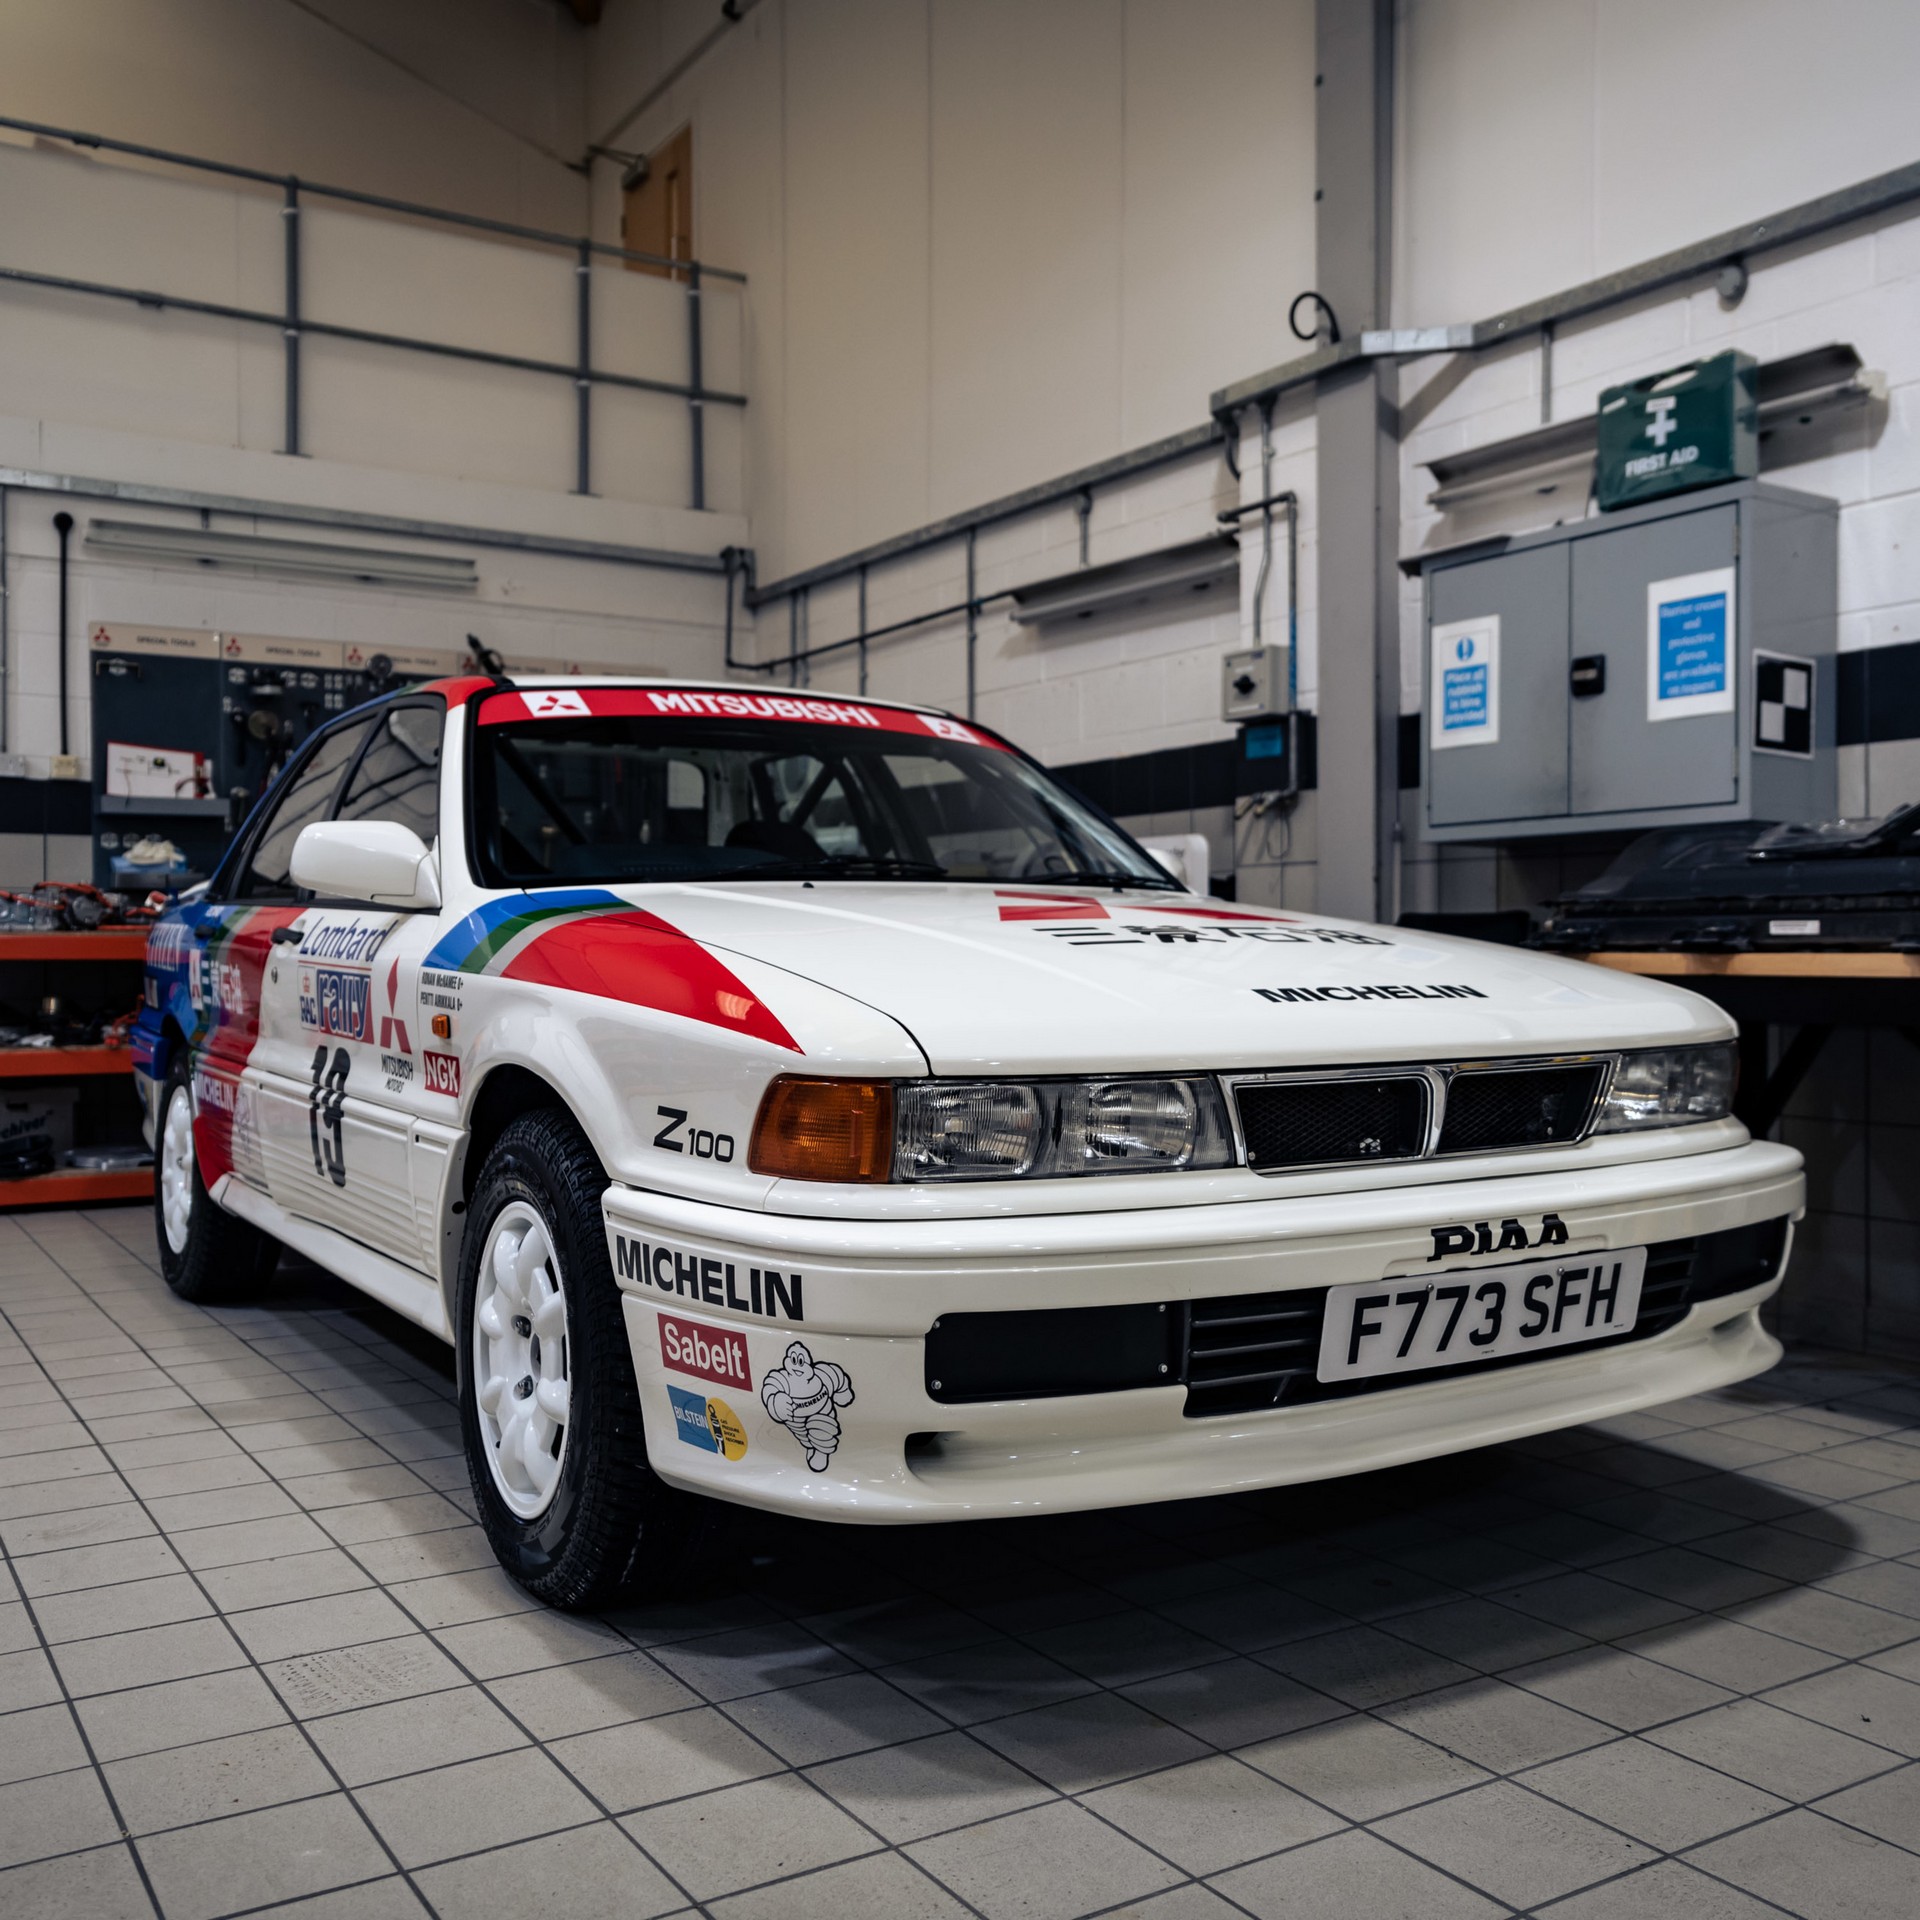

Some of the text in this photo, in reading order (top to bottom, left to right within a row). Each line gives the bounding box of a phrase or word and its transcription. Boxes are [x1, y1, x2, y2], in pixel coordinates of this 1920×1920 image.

[1625, 452, 1668, 478] FIRST
[1669, 445, 1700, 467] AID
[647, 692, 881, 727] MITSUBISHI
[299, 916, 399, 962] Lombard
[299, 995, 317, 1026] RAC
[318, 972, 371, 1041] rally
[1251, 985, 1490, 1003] MICHELIN
[381, 1053, 413, 1081] MITSUBISHI
[425, 1053, 459, 1093] NGK
[309, 1044, 351, 1188] 19
[653, 1105, 735, 1163] Z100
[1427, 1213, 1570, 1262] PIAA
[616, 1234, 804, 1322] MICHELIN
[1347, 1262, 1622, 1365] F773 SFH
[664, 1322, 745, 1380] Sabelt
[673, 1405, 709, 1429] BILSTEIN
[796, 1390, 828, 1408] MICHELIN
